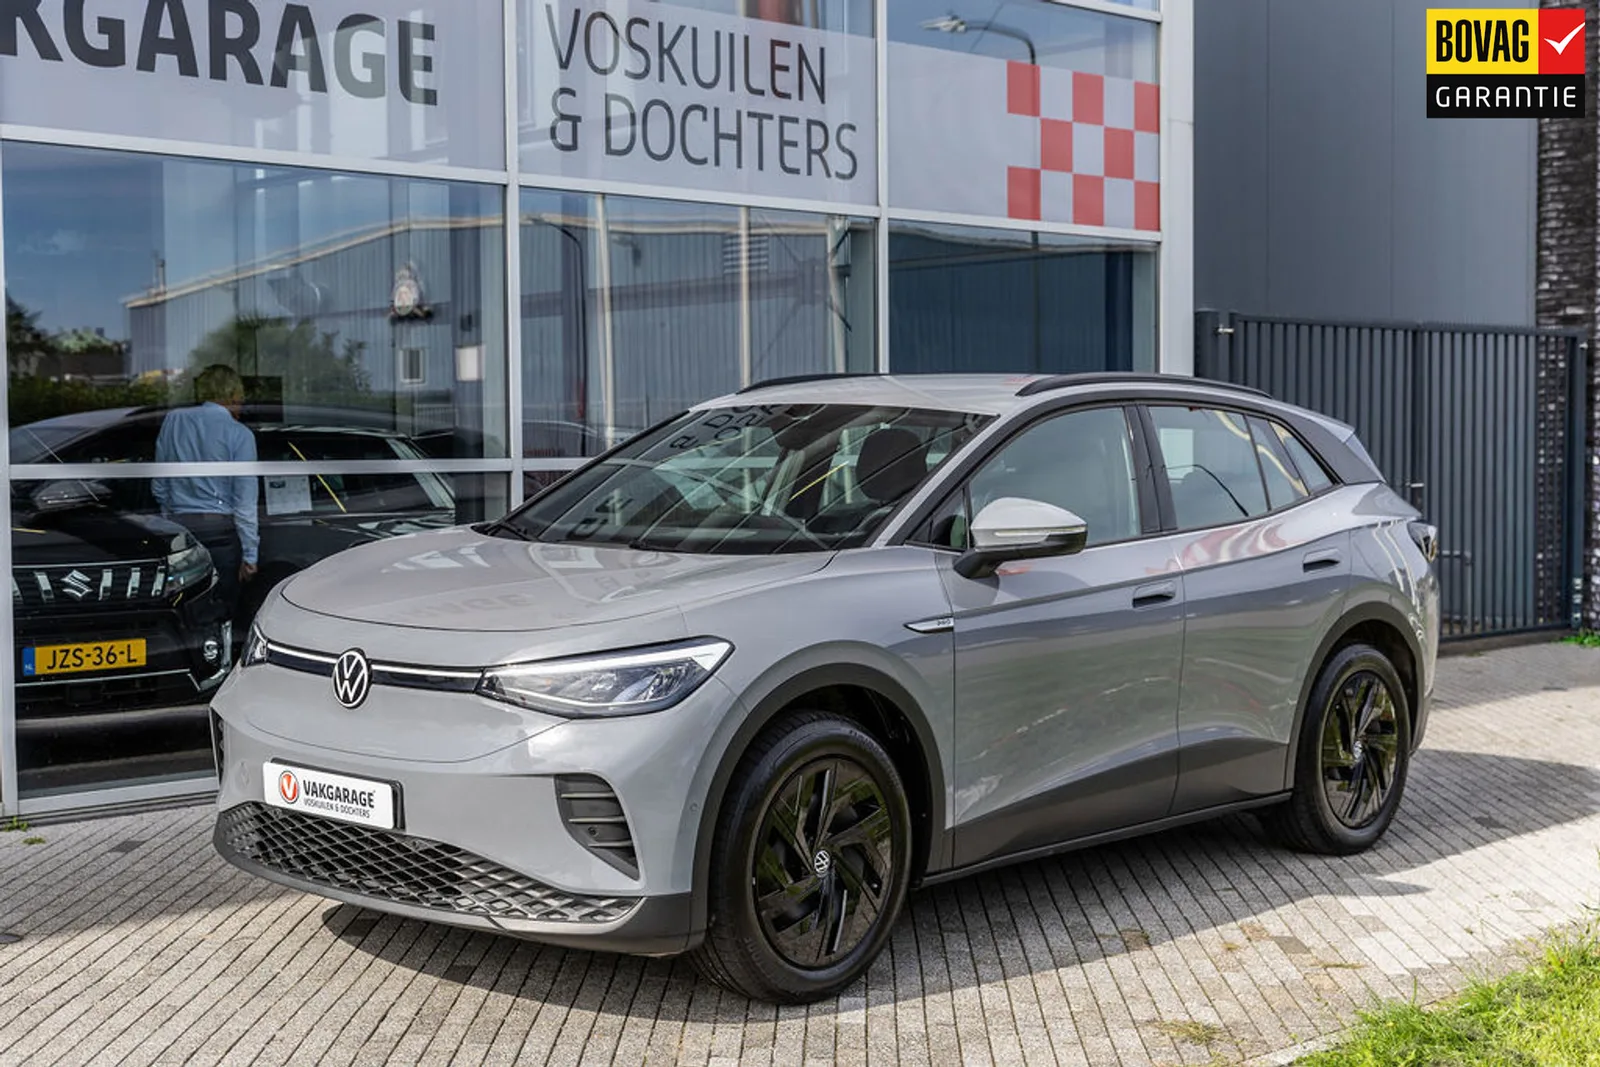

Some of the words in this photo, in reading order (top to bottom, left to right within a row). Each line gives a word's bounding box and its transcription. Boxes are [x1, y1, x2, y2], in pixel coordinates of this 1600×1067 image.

[546, 4, 826, 105] VOSKUILEN
[550, 87, 582, 152] &
[604, 93, 858, 181] DOCHTERS
[46, 643, 137, 670] JZS-36-L
[303, 780, 375, 809] VAKGARAGE
